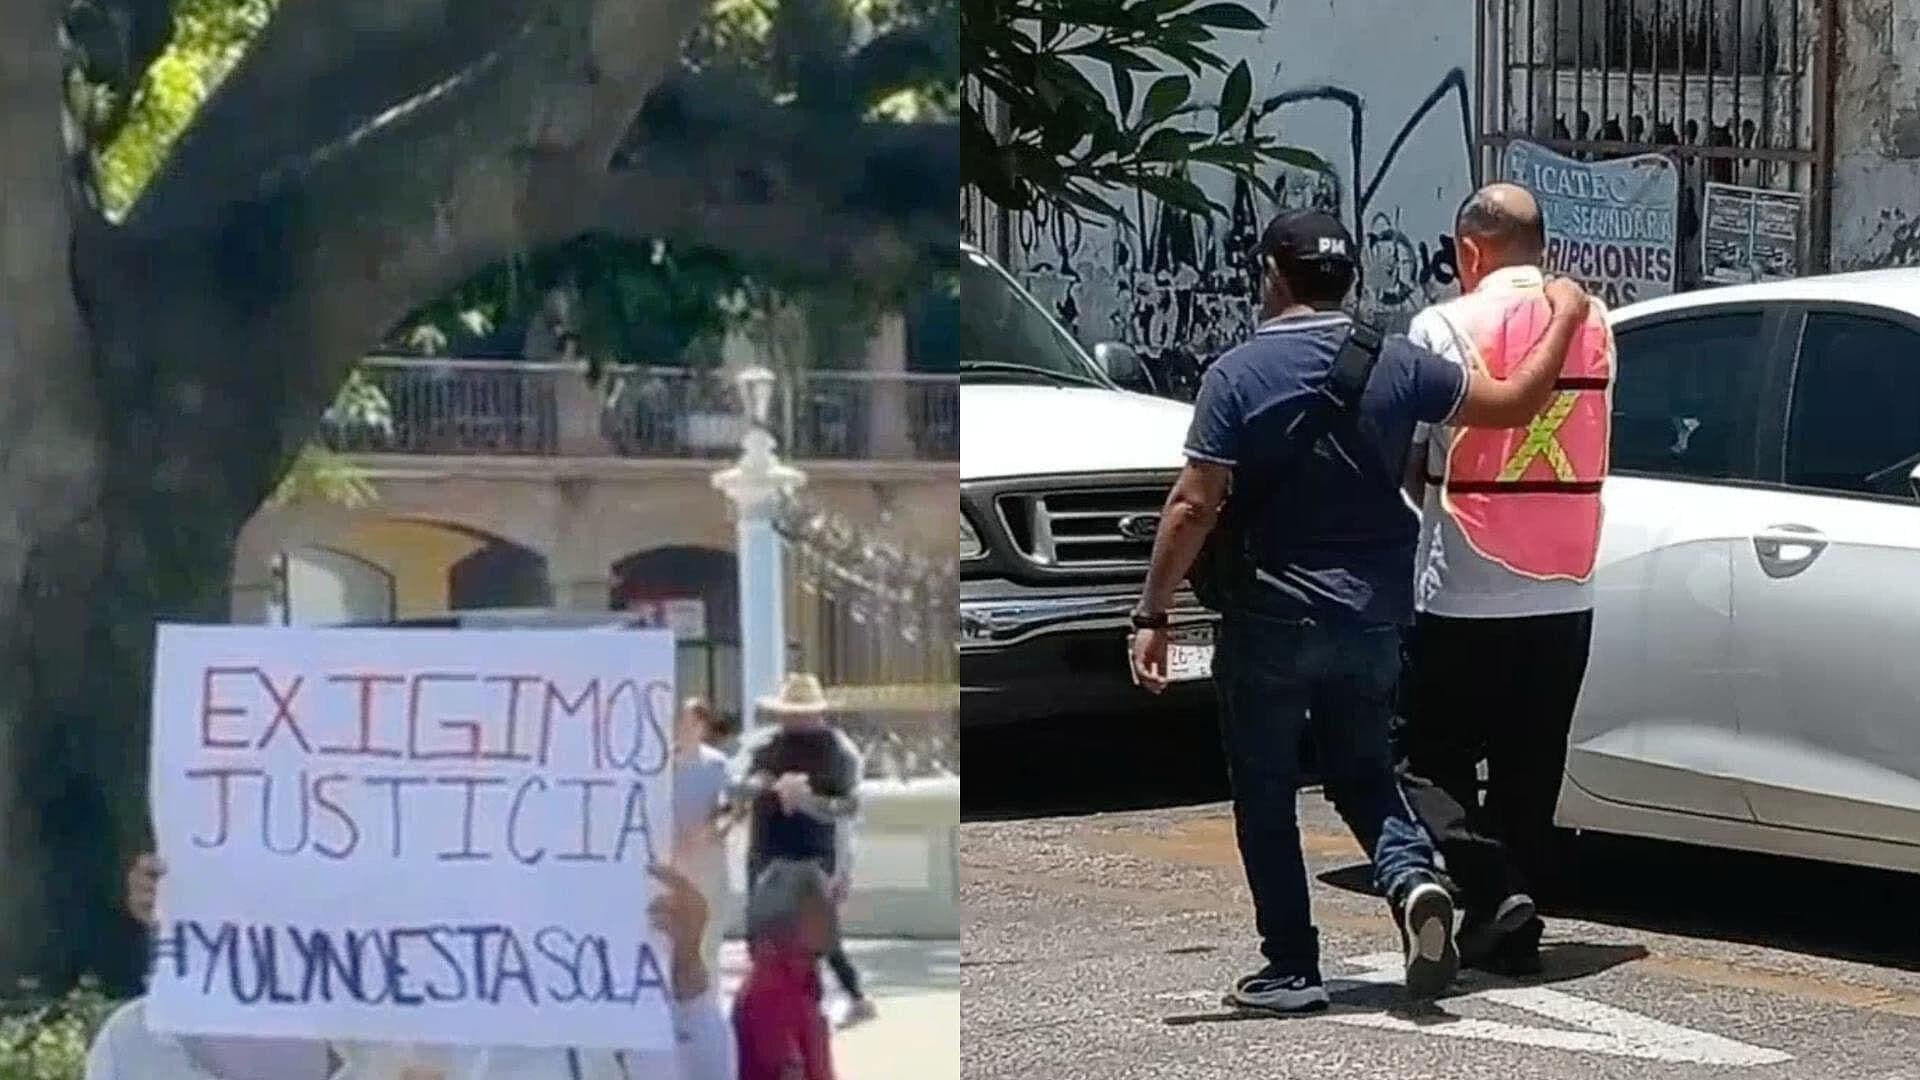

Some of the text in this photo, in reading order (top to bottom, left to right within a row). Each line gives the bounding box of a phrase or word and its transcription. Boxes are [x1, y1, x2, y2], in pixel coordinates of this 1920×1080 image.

[1542, 237, 1672, 283] RIPCIONES
[201, 666, 672, 775] EXIGIMOS
[184, 768, 658, 865] JUSTICIA
